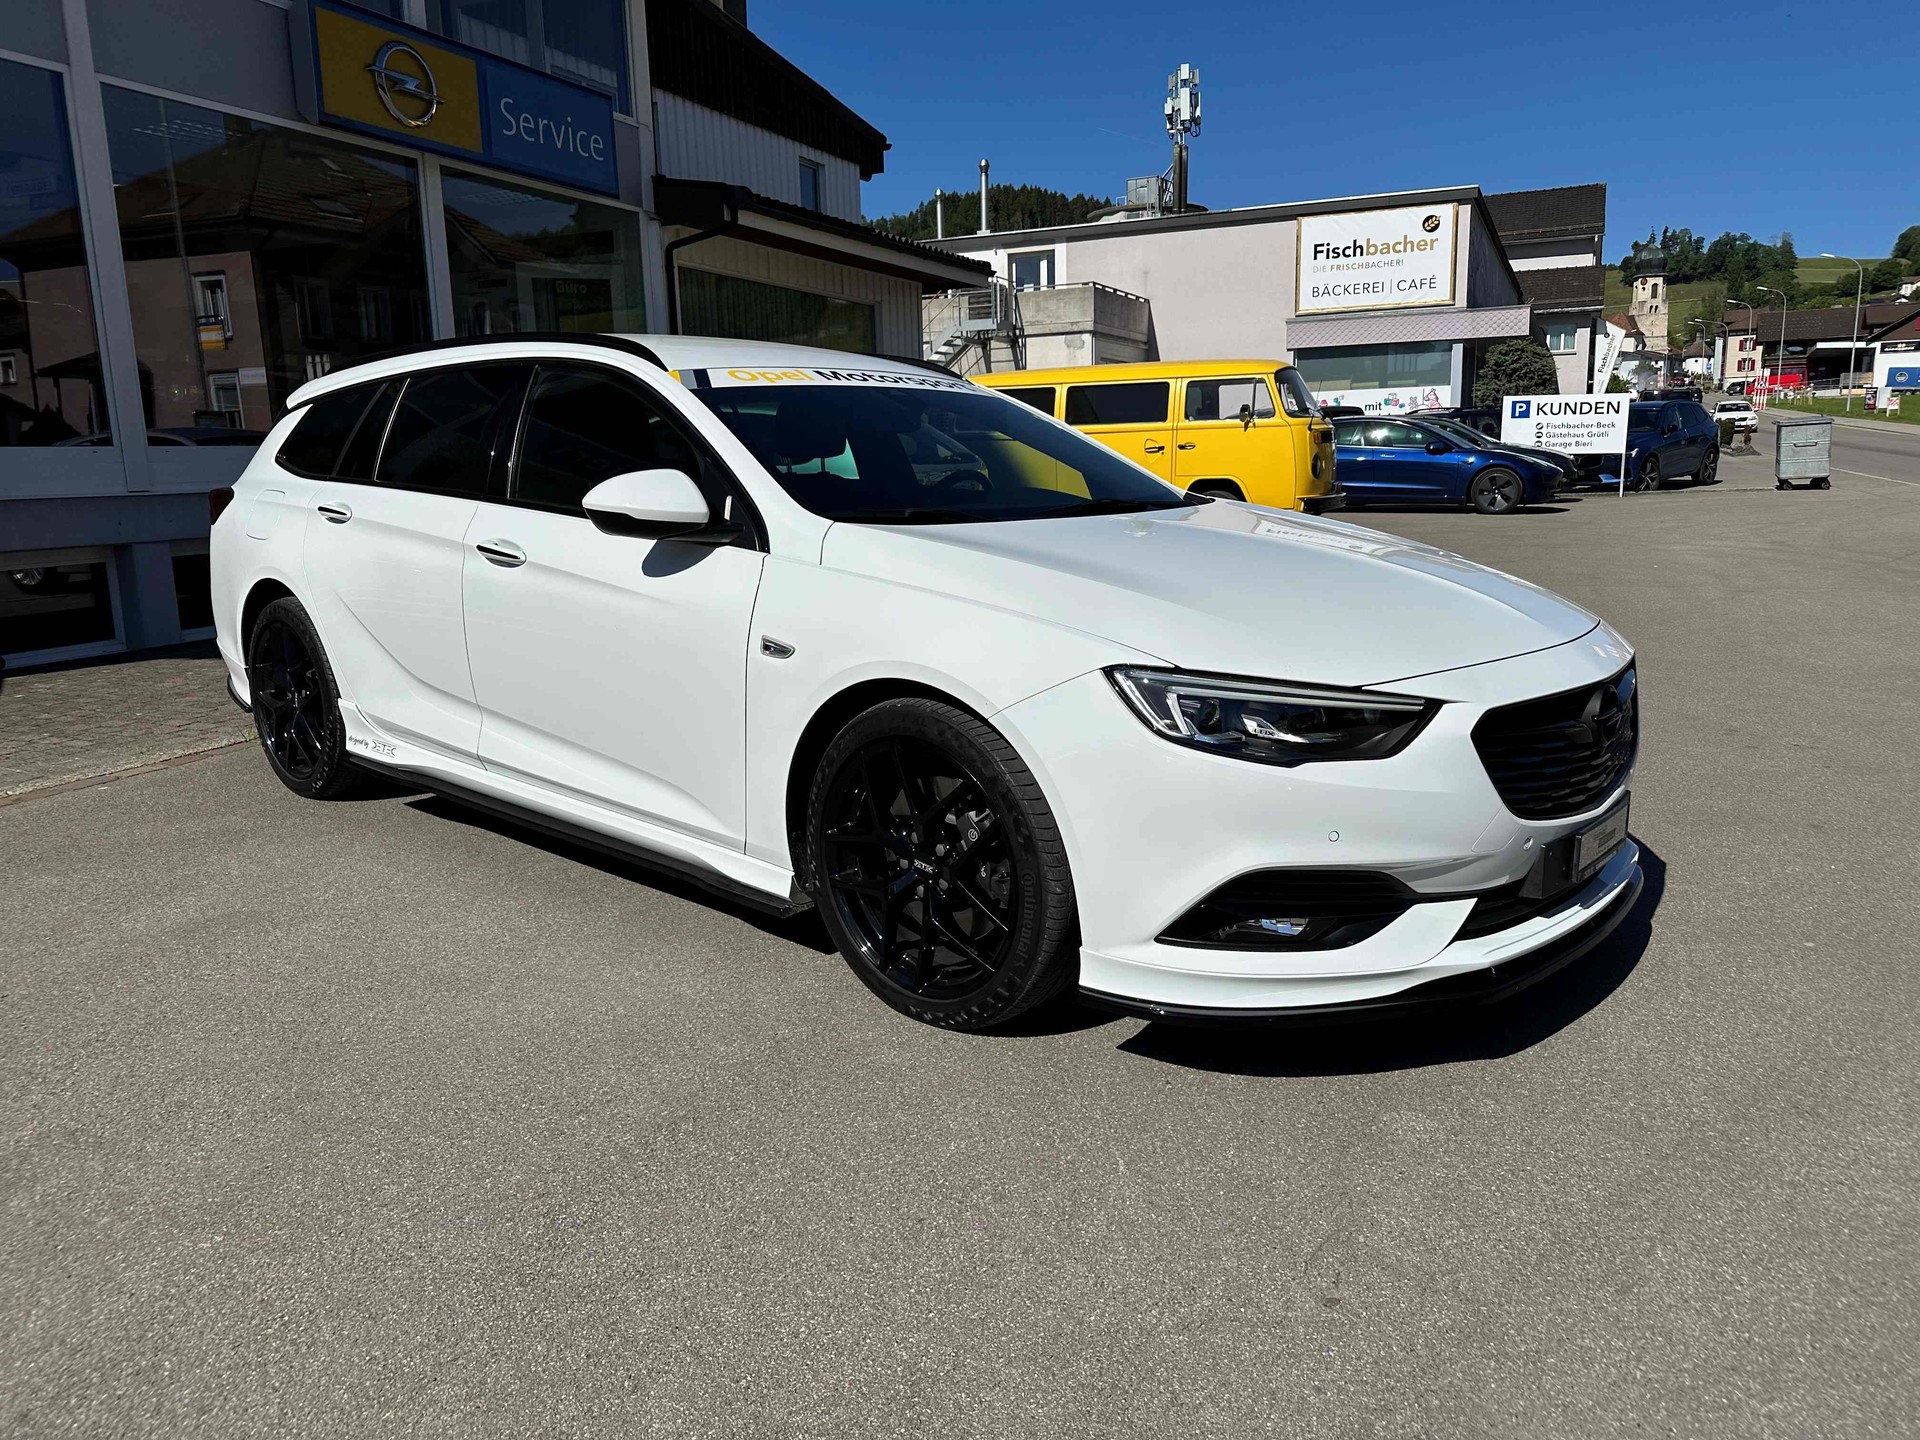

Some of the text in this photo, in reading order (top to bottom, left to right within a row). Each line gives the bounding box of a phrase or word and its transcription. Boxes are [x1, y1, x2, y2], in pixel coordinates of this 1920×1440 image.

[500, 97, 604, 161] Service
[1313, 235, 1439, 260] Fischbacher
[1312, 265, 1327, 273] DIE
[555, 280, 588, 294] Büro
[1312, 275, 1437, 298] BÄCKEREI CAFÉ
[1598, 334, 1616, 373] Fischbacher
[728, 369, 975, 392] Opel Motorsport
[1364, 402, 1382, 411] mit
[1515, 401, 1621, 417] P KUNDEN
[1546, 422, 1616, 430] Fischbacher-Beck
[1545, 430, 1609, 439] Gästehaus Grütli
[1545, 441, 1572, 449] Garage
[1016, 868, 1037, 957] Continental
